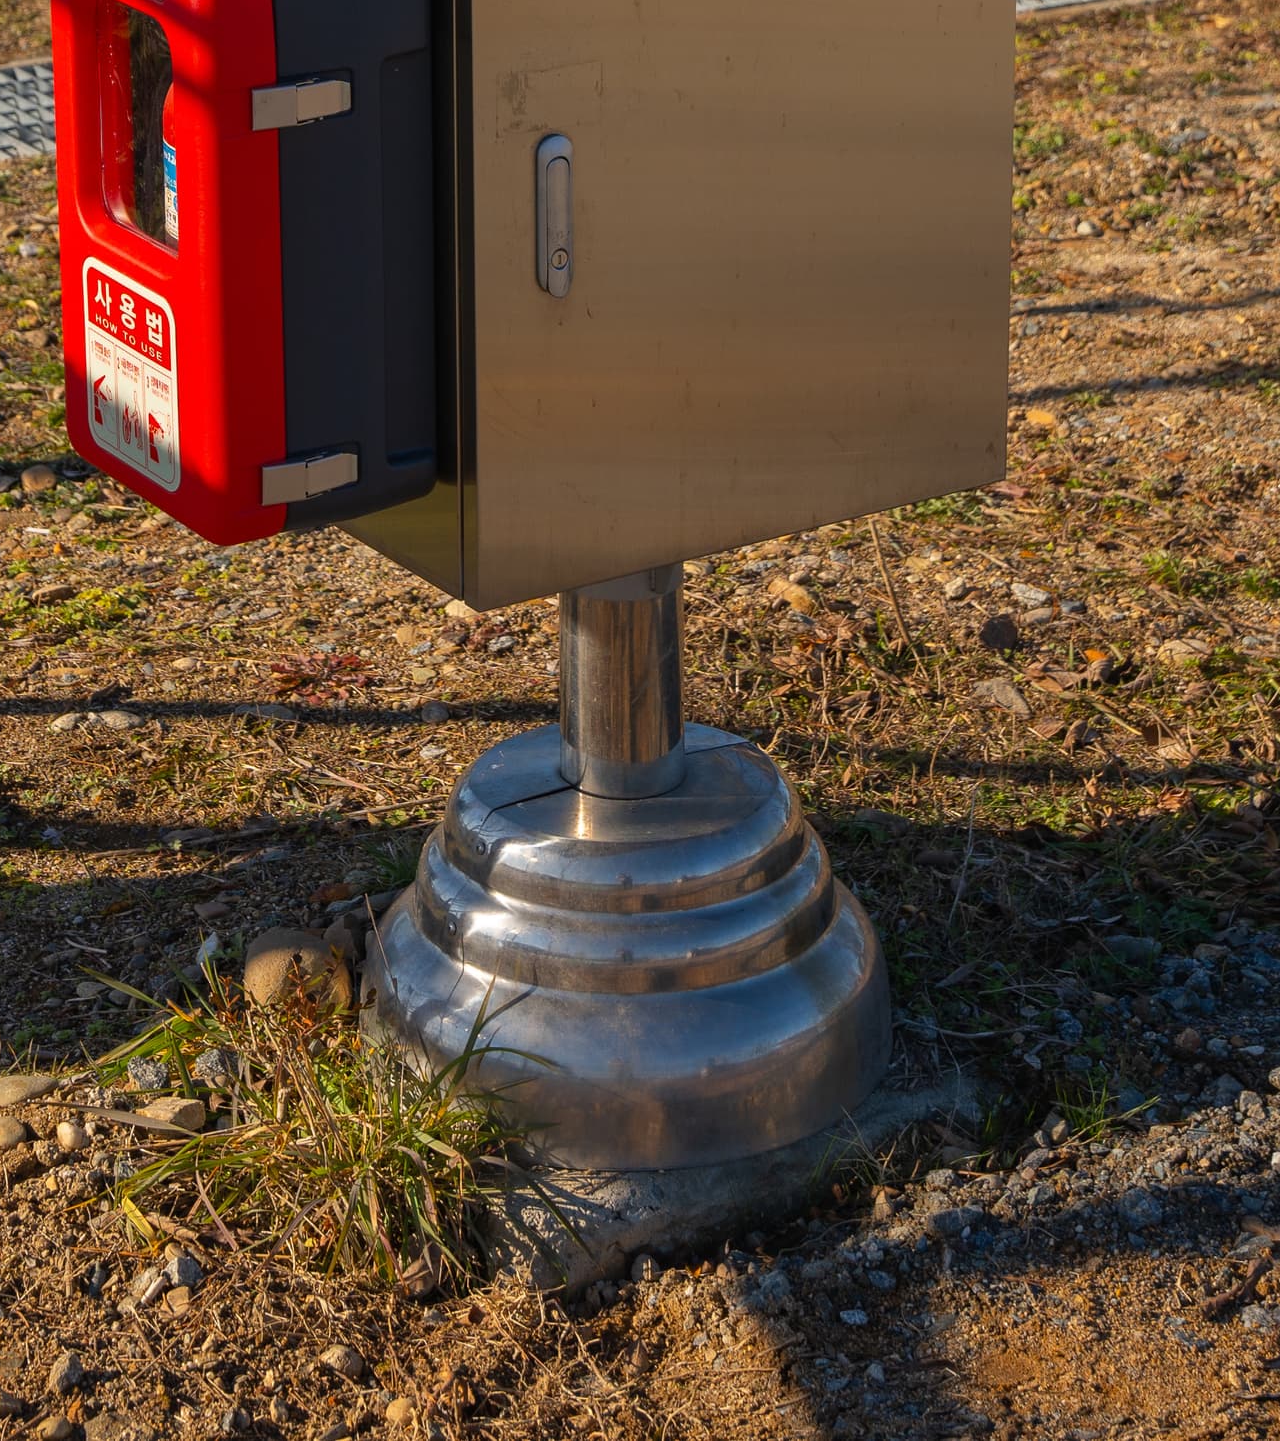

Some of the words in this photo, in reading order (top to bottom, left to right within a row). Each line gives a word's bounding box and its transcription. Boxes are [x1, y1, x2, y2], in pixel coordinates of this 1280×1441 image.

[95, 279, 163, 347] 사용법
[95, 314, 117, 334] HOW
[122, 330, 136, 346] TO
[140, 342, 163, 361] USE
